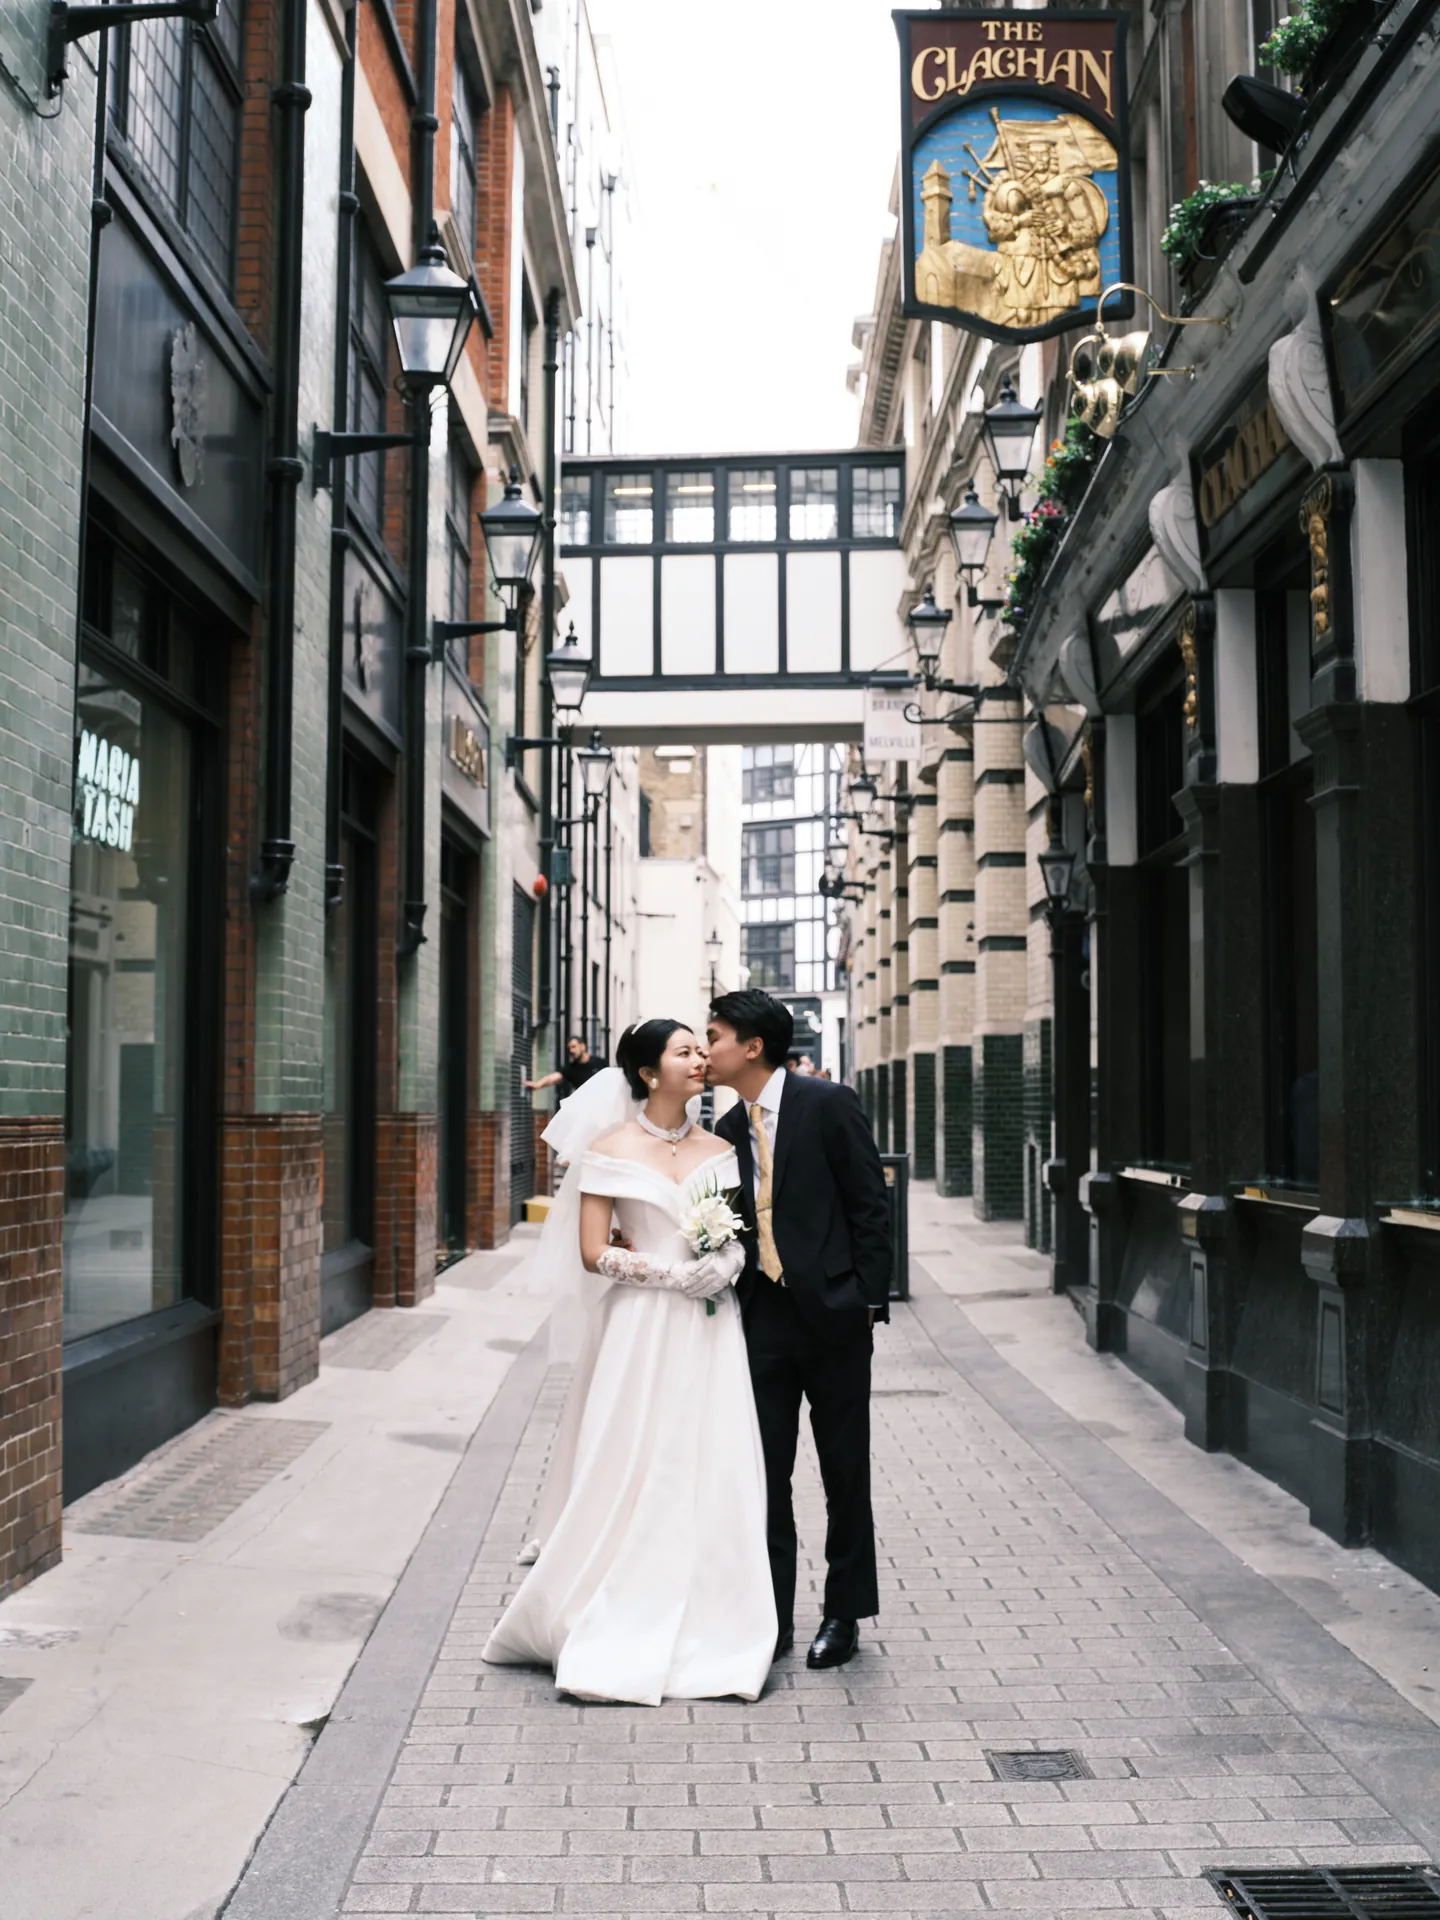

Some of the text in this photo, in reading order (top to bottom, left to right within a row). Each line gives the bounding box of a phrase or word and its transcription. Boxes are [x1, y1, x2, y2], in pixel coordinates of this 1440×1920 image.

[981, 20, 1043, 42] THE
[910, 46, 1115, 120] CLACHAN
[872, 699, 912, 711] BRAND
[869, 736, 916, 748] MELVILLE
[78, 729, 139, 806] MARIA
[83, 784, 134, 852] TASH
